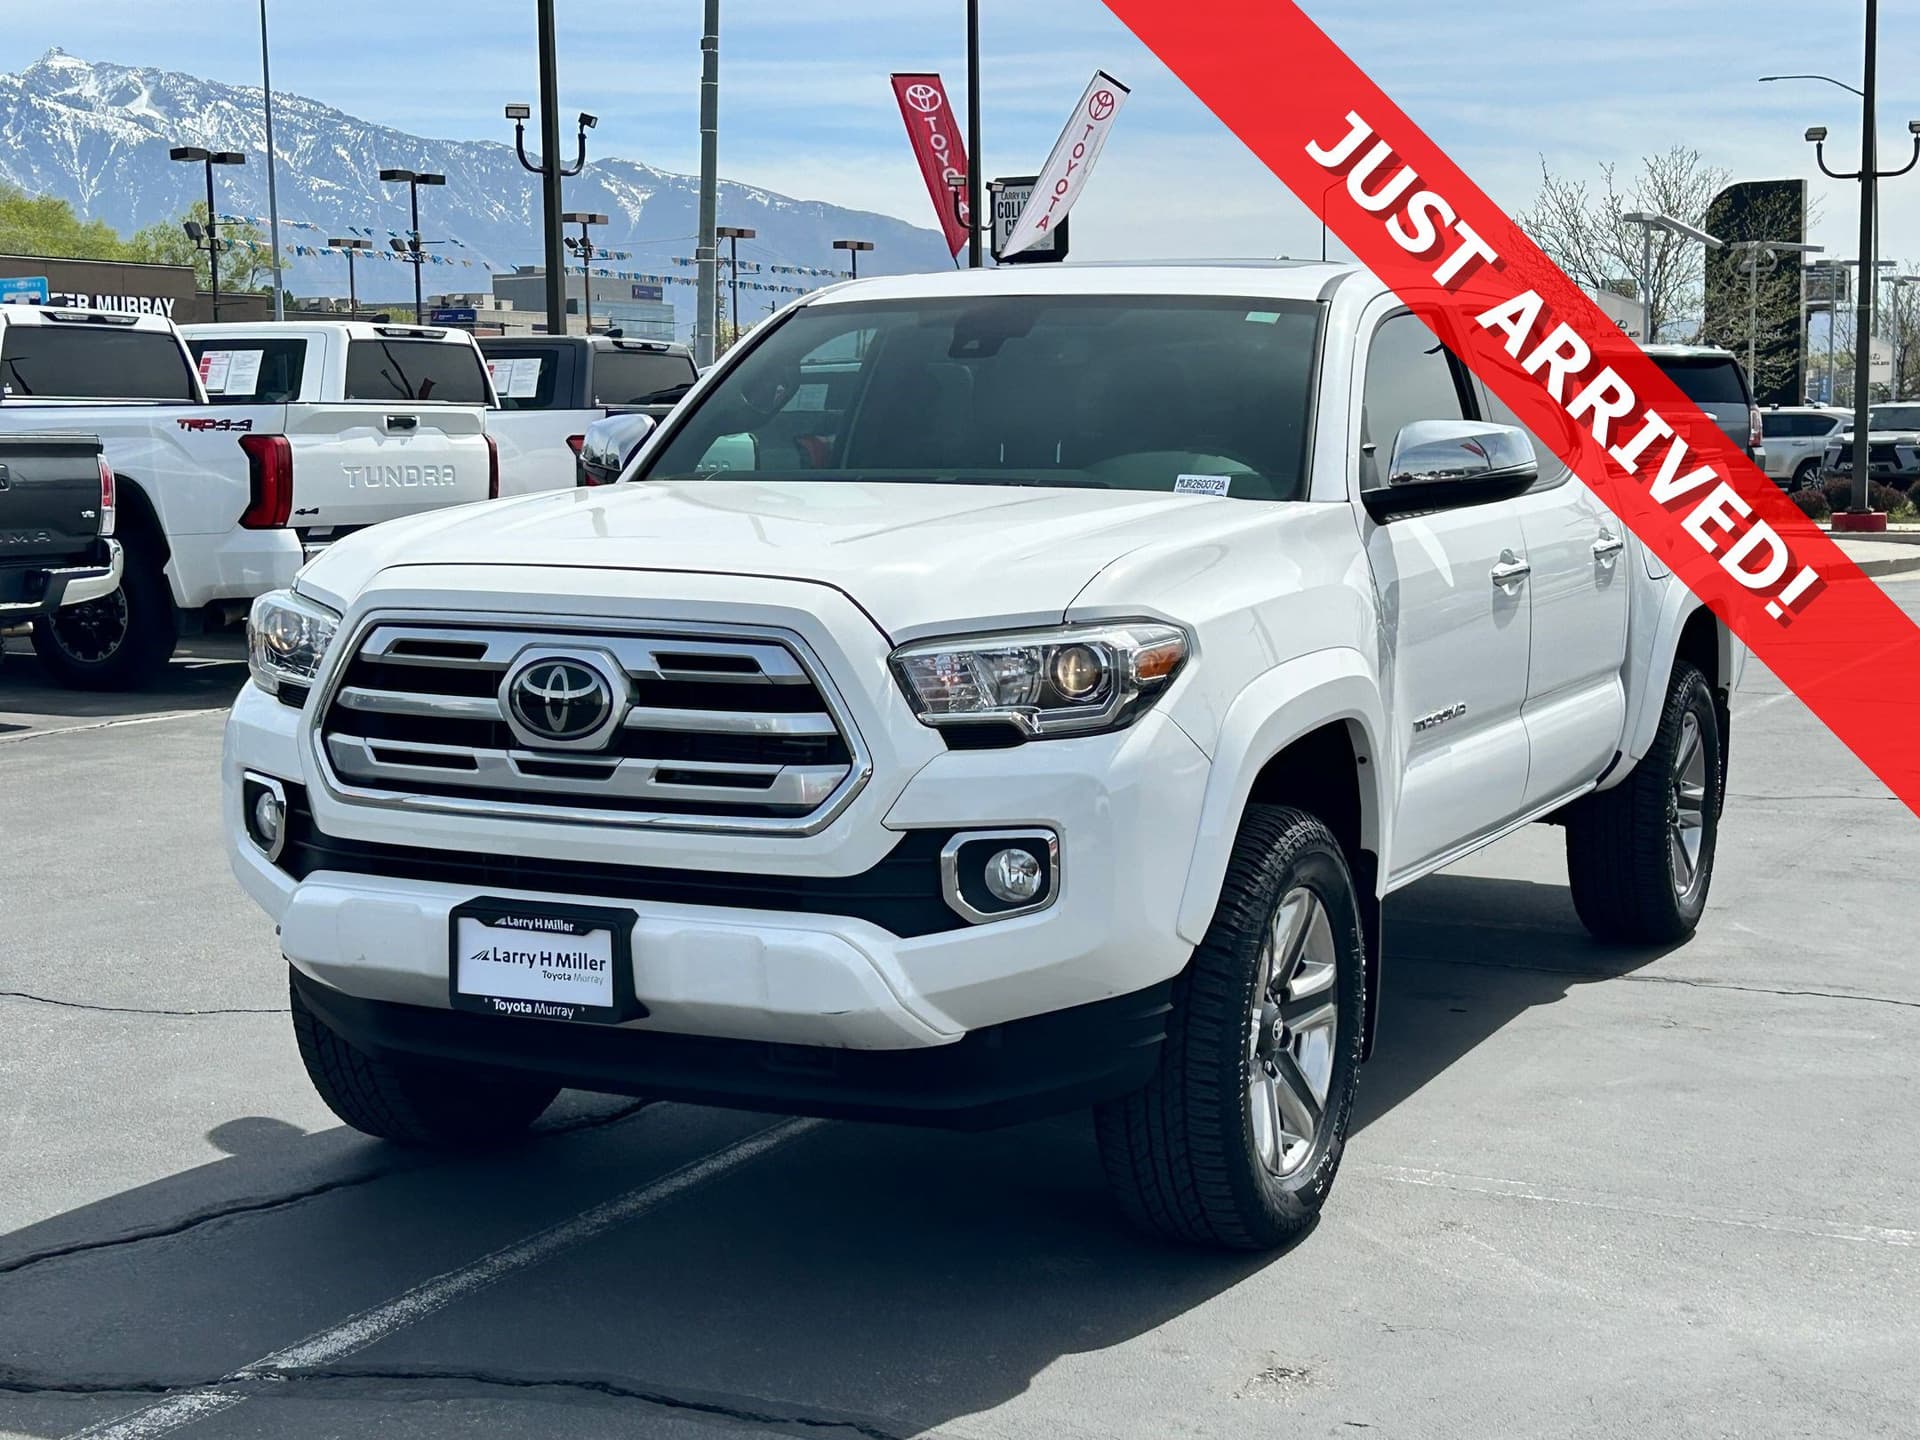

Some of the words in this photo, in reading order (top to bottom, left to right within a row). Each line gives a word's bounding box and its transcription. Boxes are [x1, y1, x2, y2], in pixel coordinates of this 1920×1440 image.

[1036, 124, 1094, 231] TOYOTA
[97, 295, 175, 317] MURRAY
[343, 464, 456, 488] TUNDRA
[507, 916, 533, 930] Larry
[535, 918, 543, 929] H
[544, 919, 574, 932] Miller
[493, 947, 536, 968] Larry
[540, 951, 551, 967] H
[556, 952, 606, 971] Miller
[542, 970, 572, 981] Toyota
[573, 973, 603, 985] Murray
[493, 998, 532, 1014] Toyota
[534, 999, 575, 1019] Murray
